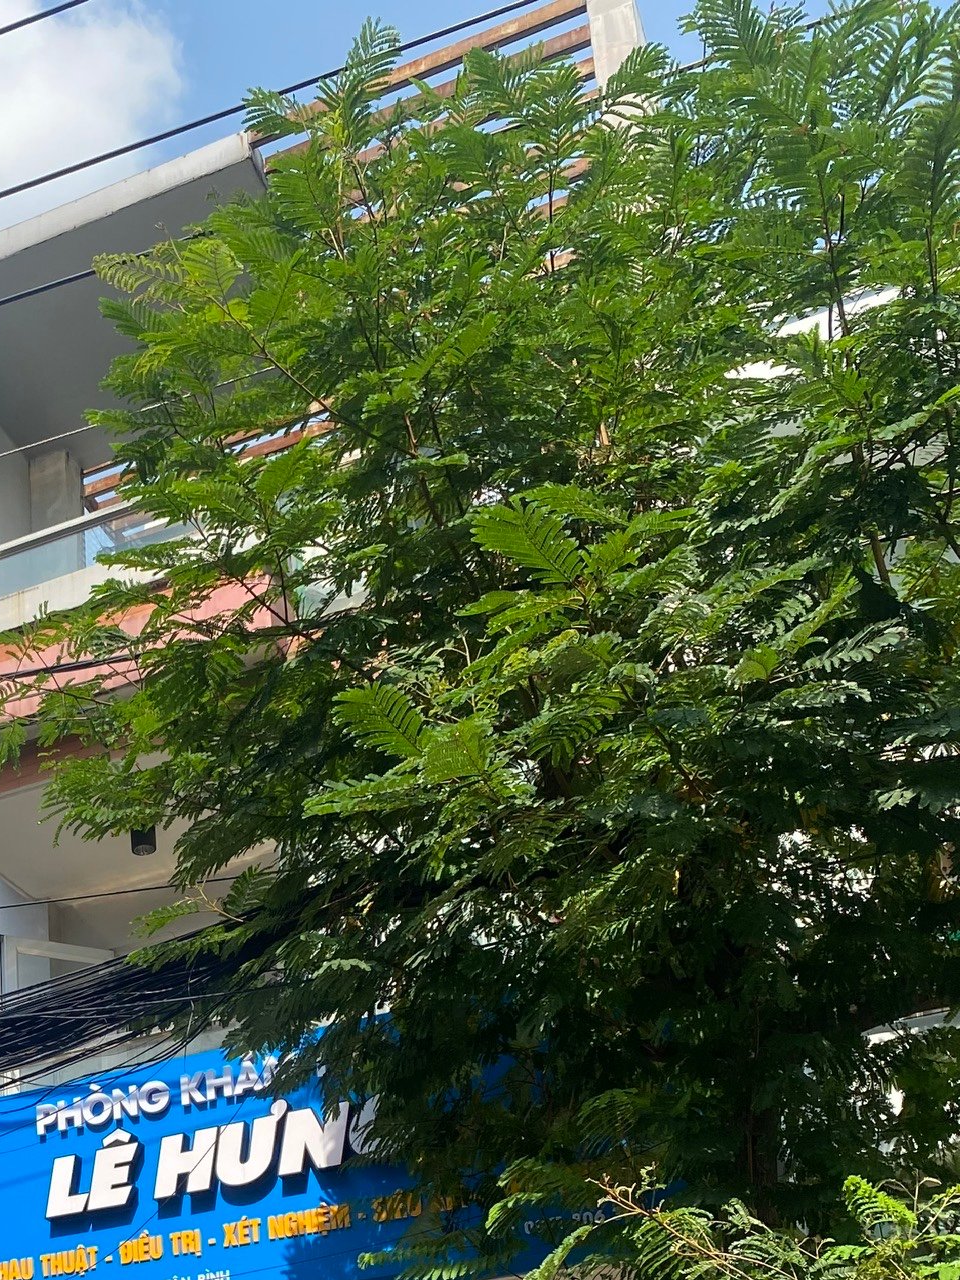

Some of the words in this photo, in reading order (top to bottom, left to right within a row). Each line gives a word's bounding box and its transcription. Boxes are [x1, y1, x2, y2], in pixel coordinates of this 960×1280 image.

[35, 1081, 170, 1136] PHÒNG
[45, 1128, 138, 1219] LÊ
[40, 1244, 98, 1278] THUẬT
[119, 1229, 163, 1265] ĐIỀU
[170, 1228, 202, 1258] TRỊ
[223, 1216, 261, 1248] XÉT
